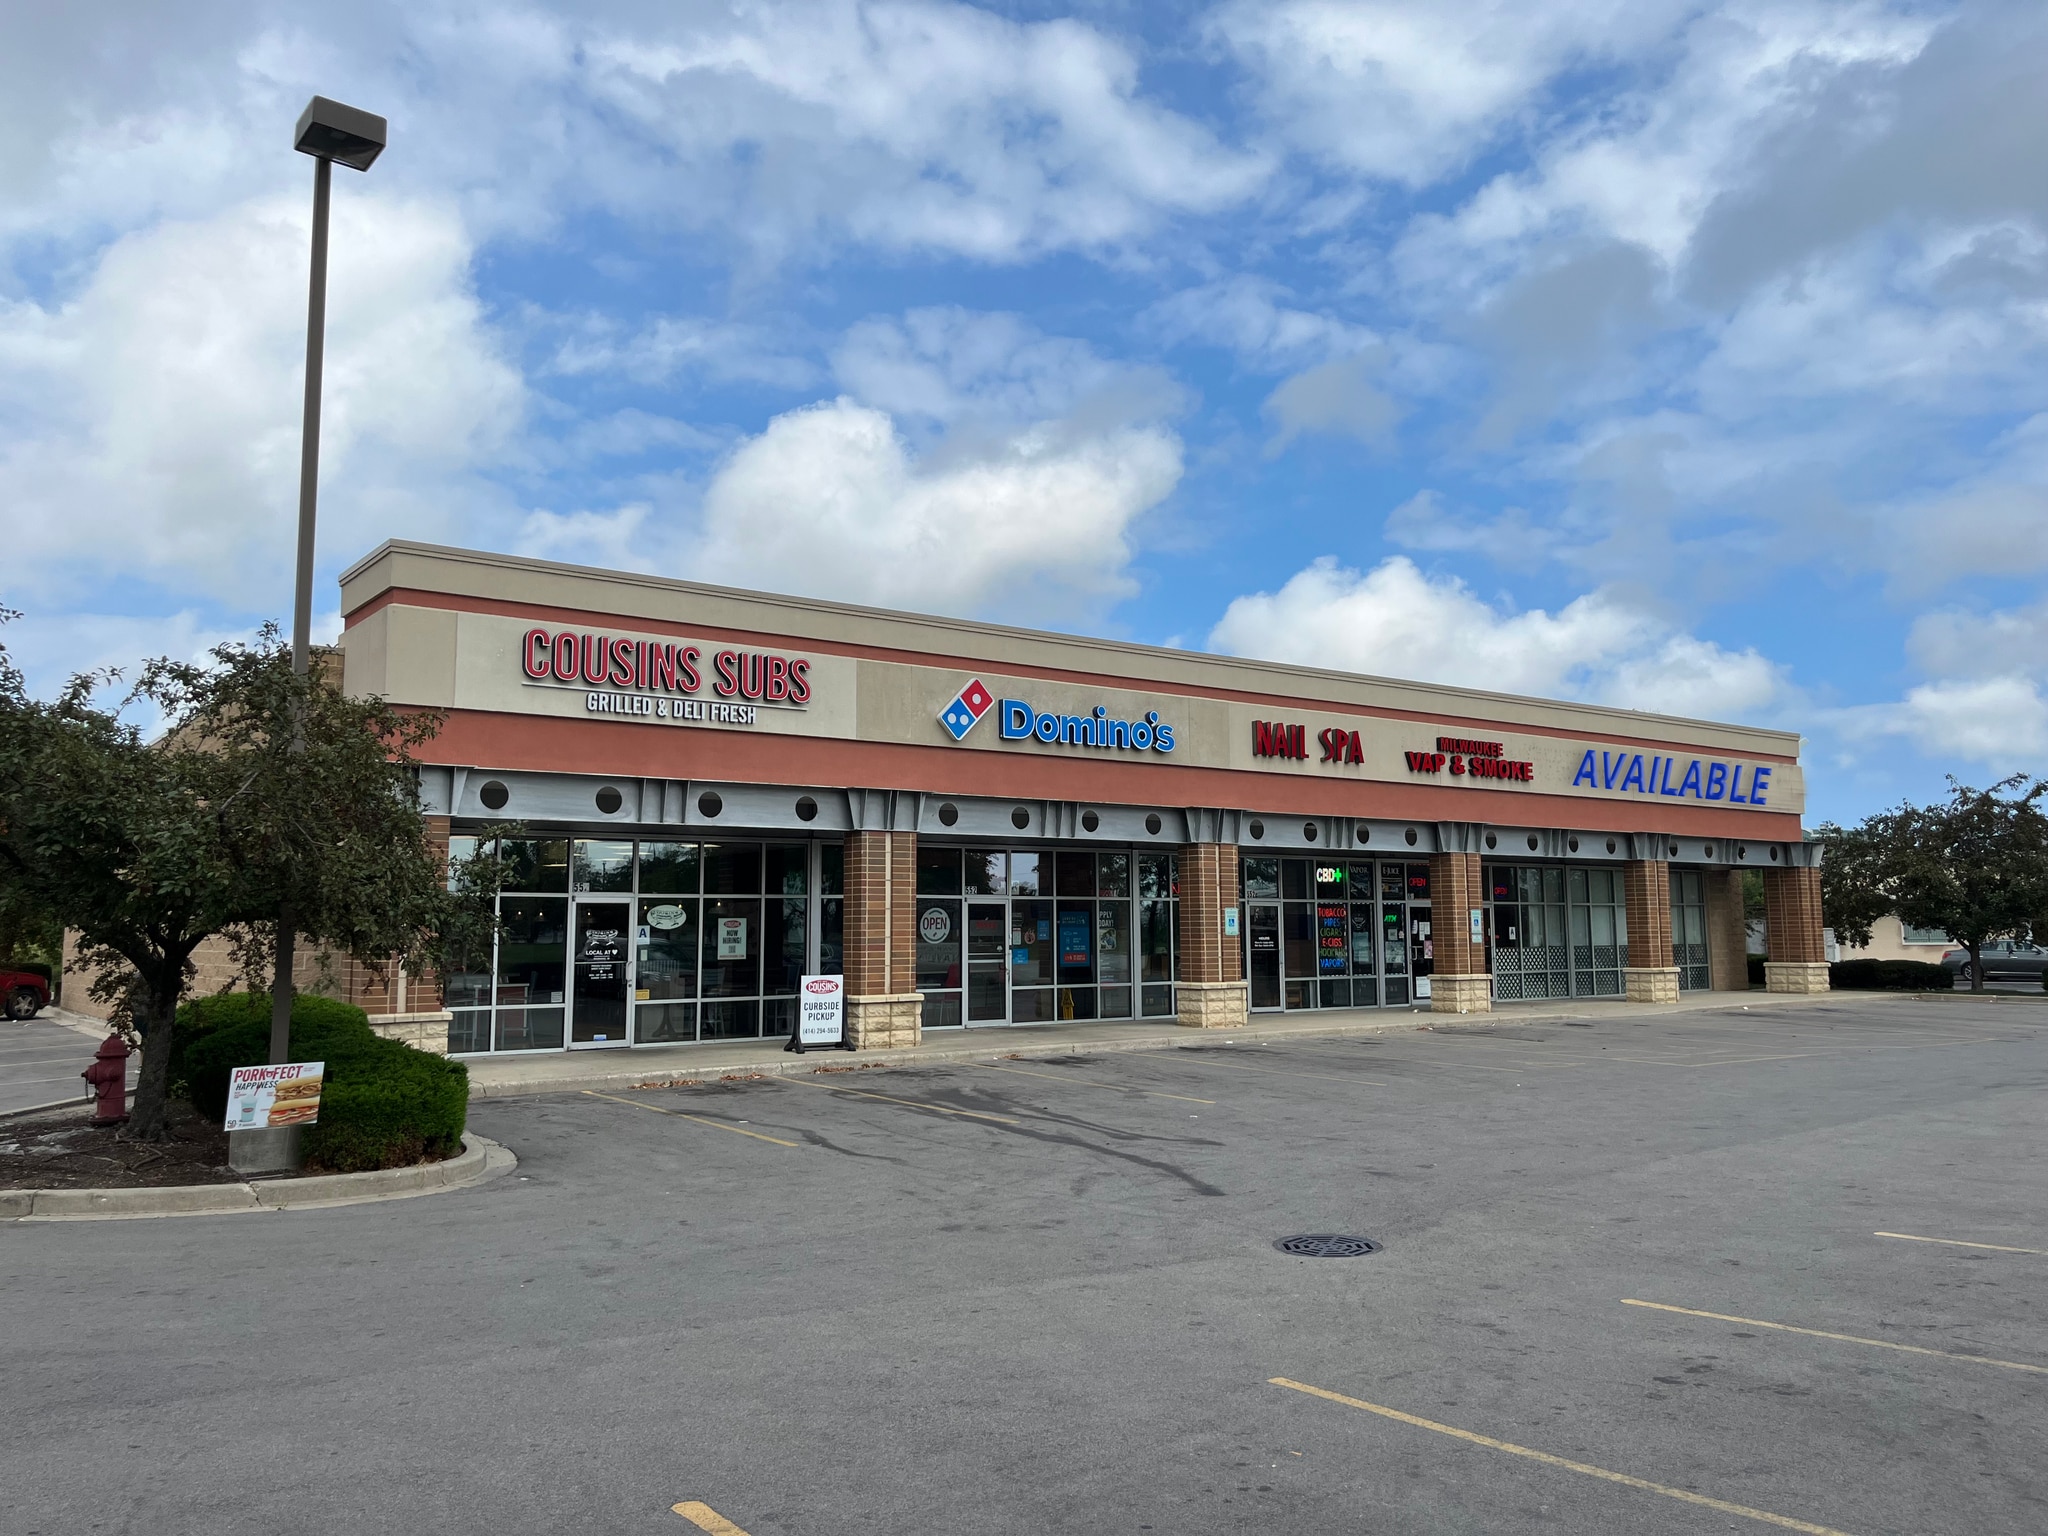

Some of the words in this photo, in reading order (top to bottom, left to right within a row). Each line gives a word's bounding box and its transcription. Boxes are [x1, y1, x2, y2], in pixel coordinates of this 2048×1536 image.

[522, 628, 702, 693] COUSINS
[714, 650, 812, 704] SUBS
[586, 692, 651, 716] GRILLED
[657, 698, 668, 717] &
[672, 699, 706, 721] DELI
[711, 704, 756, 724] FRESH
[999, 697, 1176, 753] Domino's
[1252, 719, 1309, 760] NAIL
[1317, 728, 1365, 764] SPA
[1436, 736, 1503, 757] MILWAUKEE
[1405, 751, 1446, 773] VAP
[1450, 755, 1465, 775] &
[1469, 757, 1533, 782] SMOKE
[1572, 749, 1772, 805] AVAILABLE
[1408, 877, 1426, 886] OPEN
[1318, 907, 1346, 917] TOBACCO
[922, 917, 947, 930] OPEN
[1323, 918, 1340, 927] PIPES
[639, 928, 647, 938] A
[1320, 928, 1342, 937] CIGARS
[1322, 938, 1343, 947] E-CIGS
[1319, 948, 1347, 957] HOOKAHS
[1320, 958, 1345, 968] VAPORS
[808, 982, 838, 991] COUSINS
[804, 1002, 839, 1011] CURBSIDE
[808, 1012, 835, 1020] PICKUP
[235, 1080, 278, 1091] HAPPINESS
